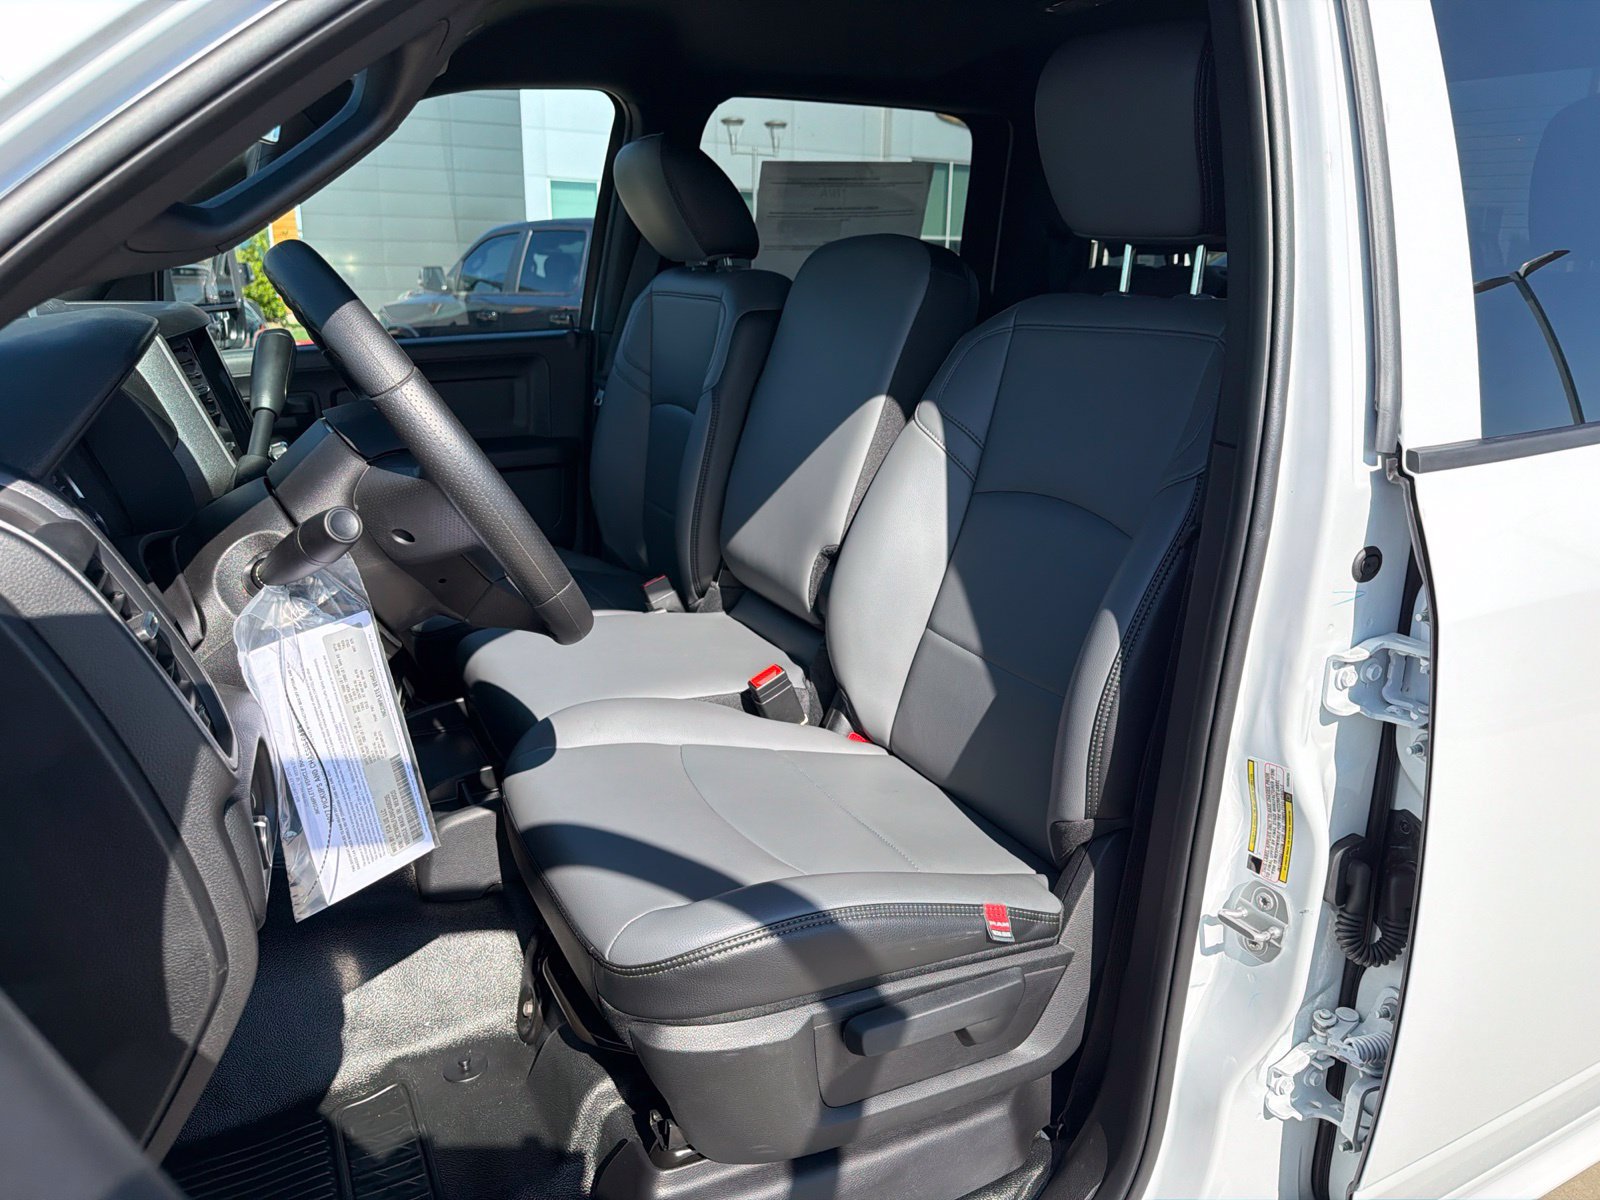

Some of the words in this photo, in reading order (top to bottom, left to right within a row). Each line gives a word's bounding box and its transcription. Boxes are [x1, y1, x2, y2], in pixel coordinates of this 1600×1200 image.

[368, 668, 378, 688] VEHICLE
[374, 687, 387, 718] INCOMPLETE
[303, 742, 316, 769] CHASSIS
[312, 769, 321, 783] AND
[316, 783, 329, 809] PICKUPS
